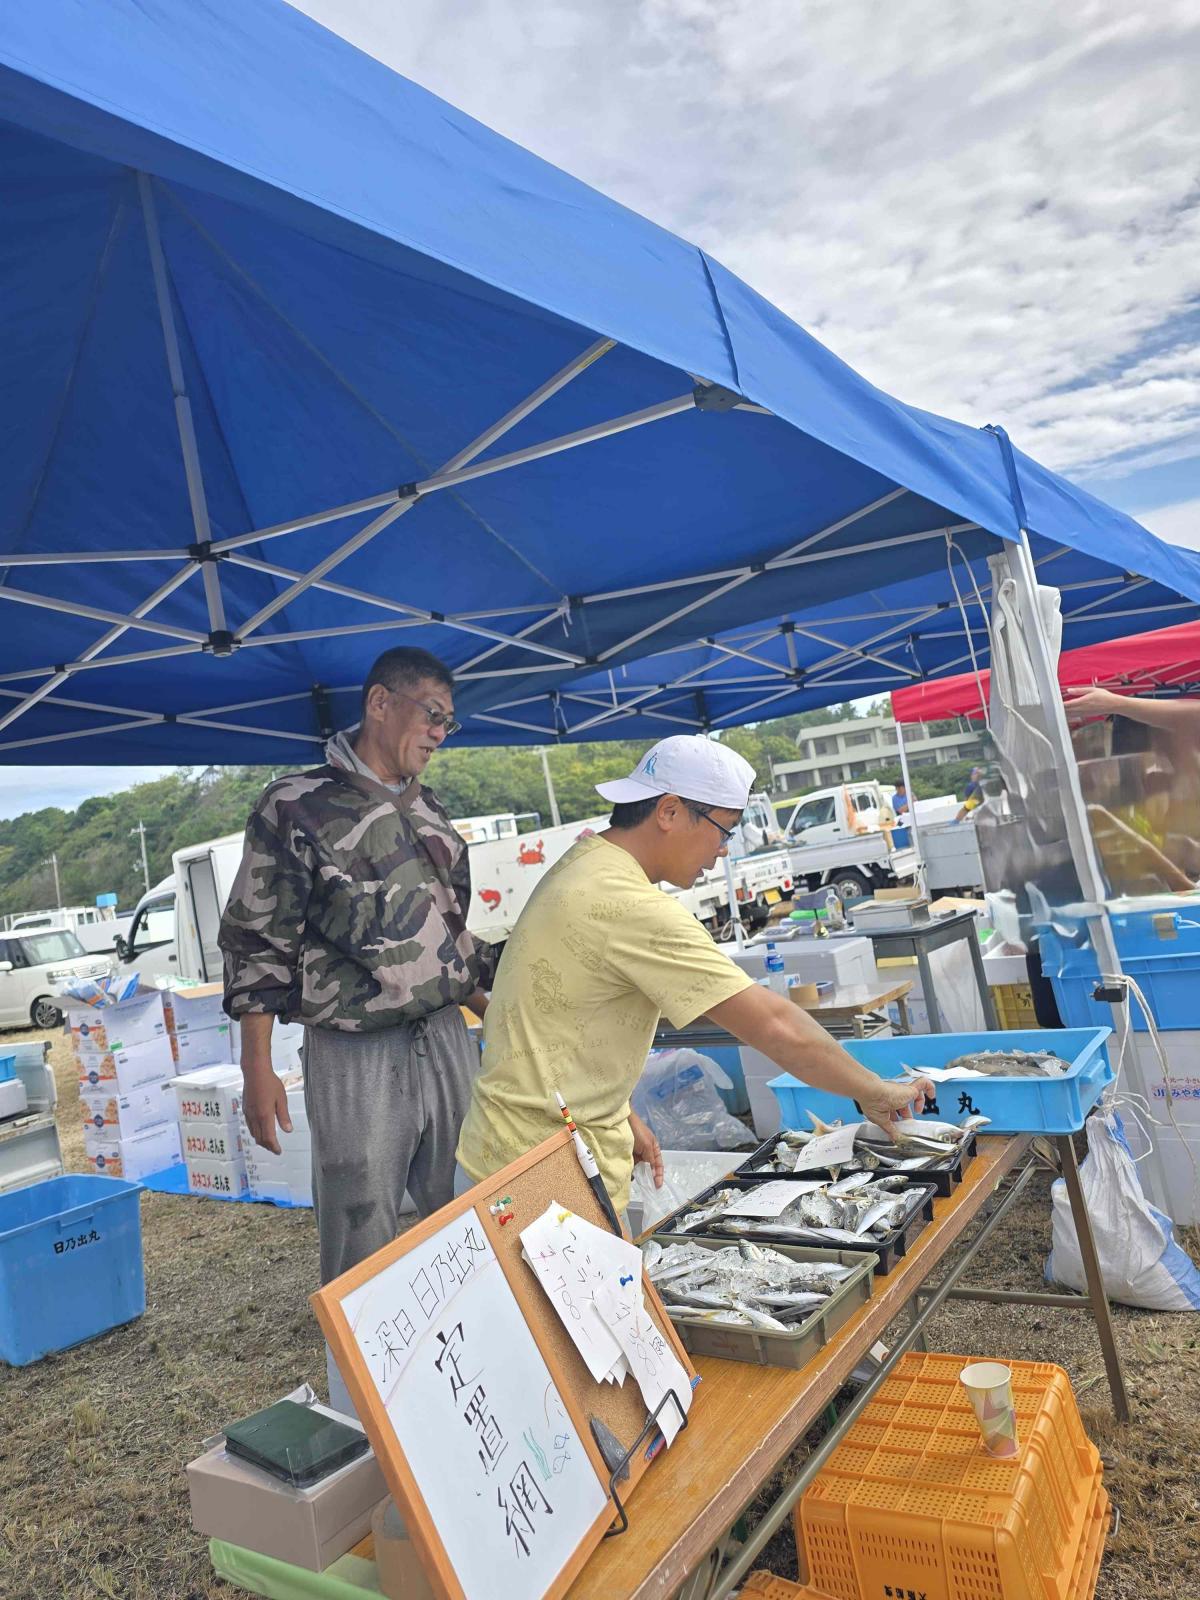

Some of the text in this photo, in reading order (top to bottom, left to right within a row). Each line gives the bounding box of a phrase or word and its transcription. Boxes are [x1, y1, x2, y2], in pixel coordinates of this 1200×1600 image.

[53, 1230, 101, 1255] 日乃出丸
[434, 1321, 554, 1559] 定置網
